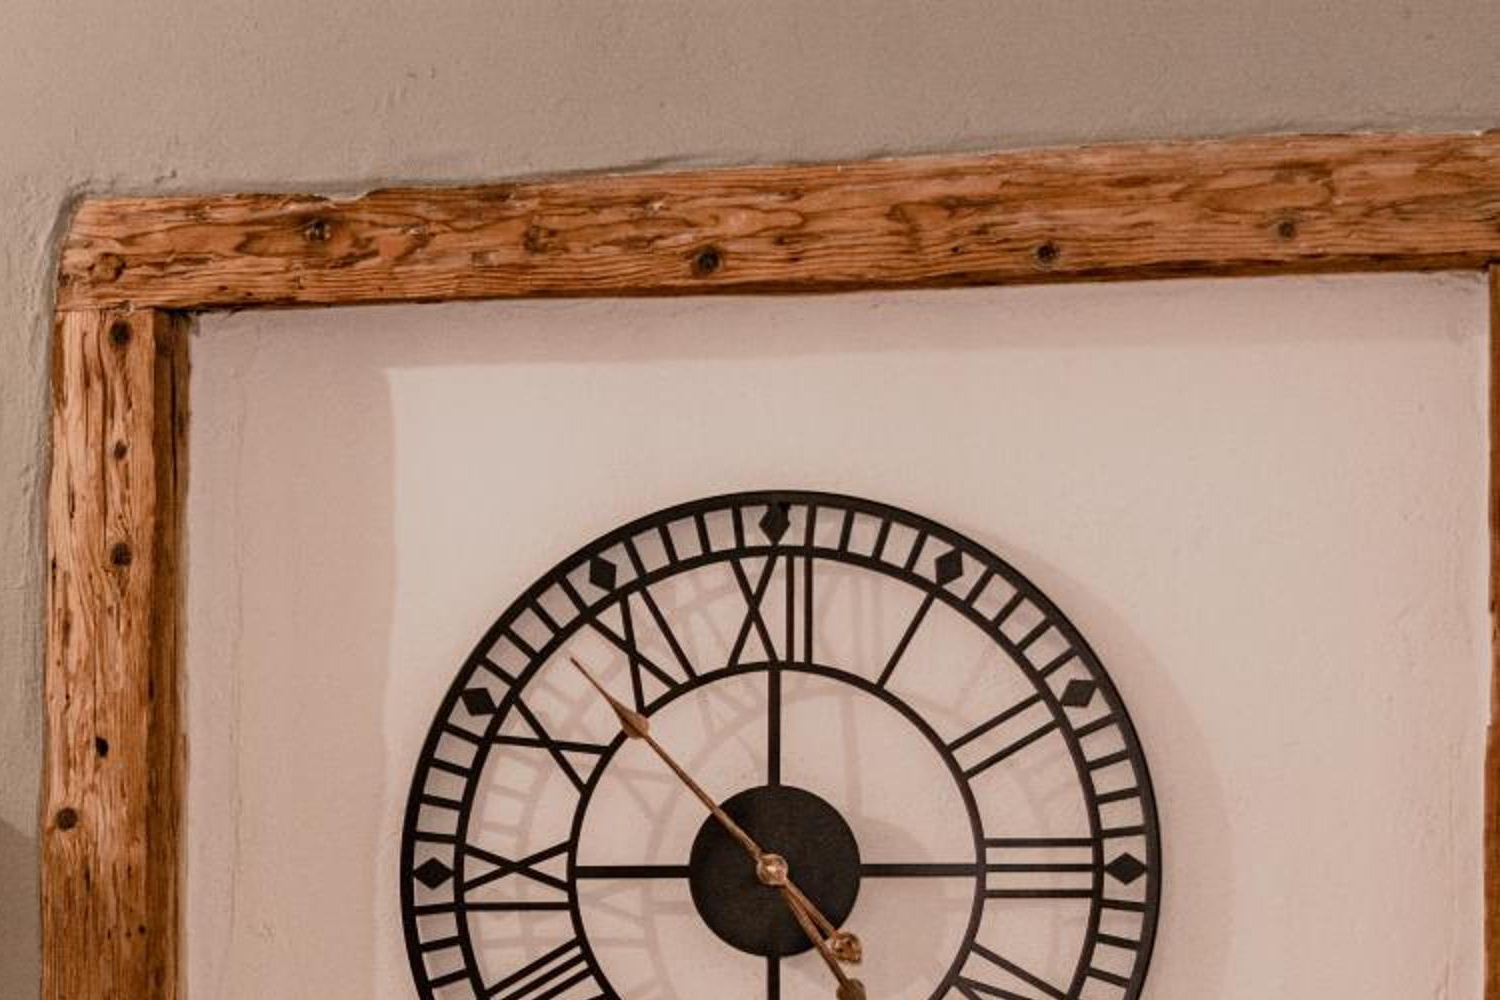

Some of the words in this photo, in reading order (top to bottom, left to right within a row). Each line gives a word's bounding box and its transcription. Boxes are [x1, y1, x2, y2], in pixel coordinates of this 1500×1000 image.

[586, 585, 697, 714] XI
[727, 553, 813, 667] XII
[495, 697, 612, 796] X
[948, 693, 1063, 780] II
[984, 837, 1096, 899] III
